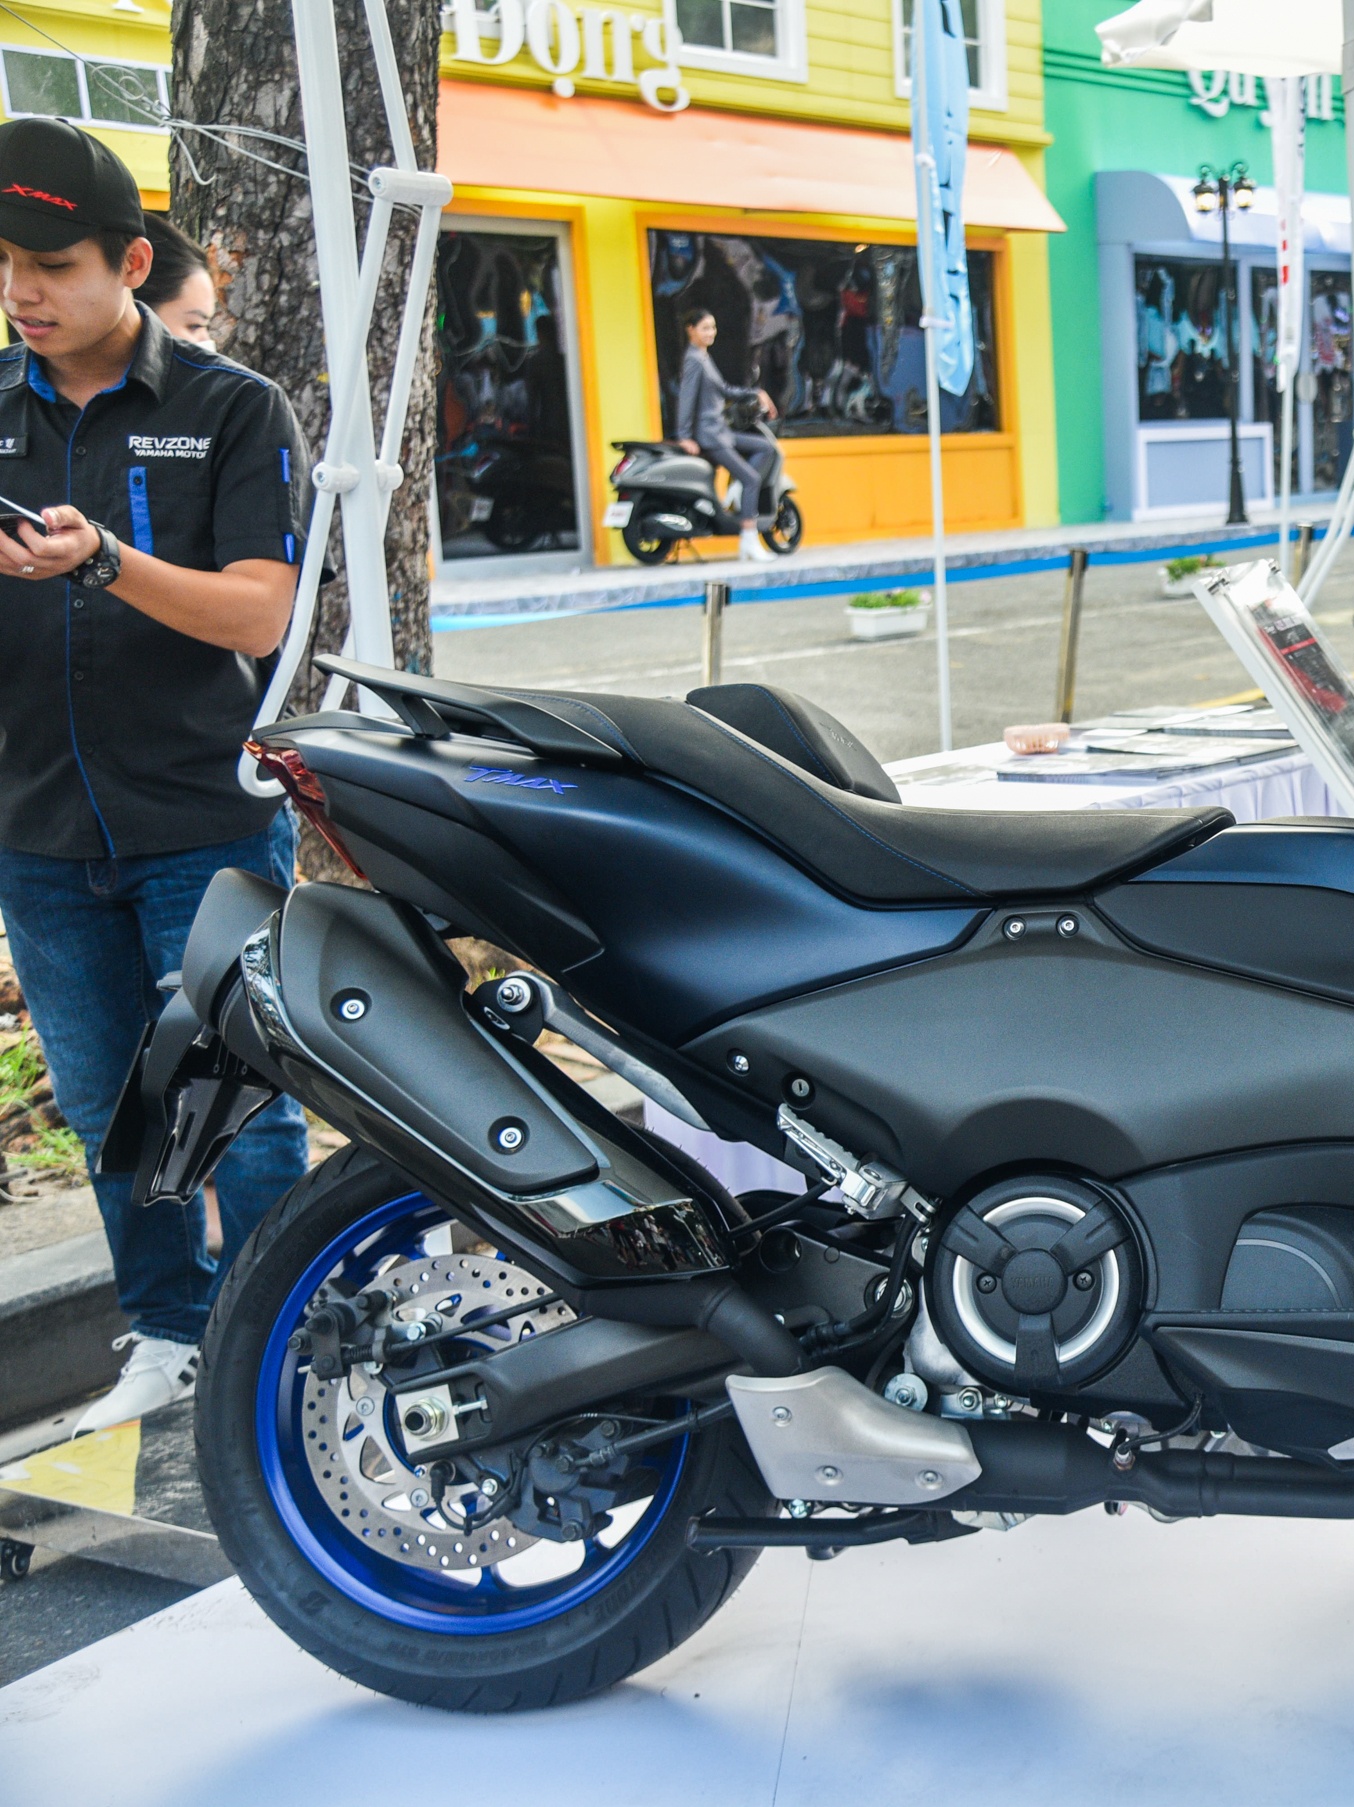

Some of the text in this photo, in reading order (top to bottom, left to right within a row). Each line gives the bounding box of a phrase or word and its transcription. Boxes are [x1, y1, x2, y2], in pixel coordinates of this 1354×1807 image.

[1, 183, 78, 211] XMAX
[128, 435, 212, 451] REVZONE
[134, 449, 175, 458] YAMAHA
[463, 765, 579, 795] TMAX
